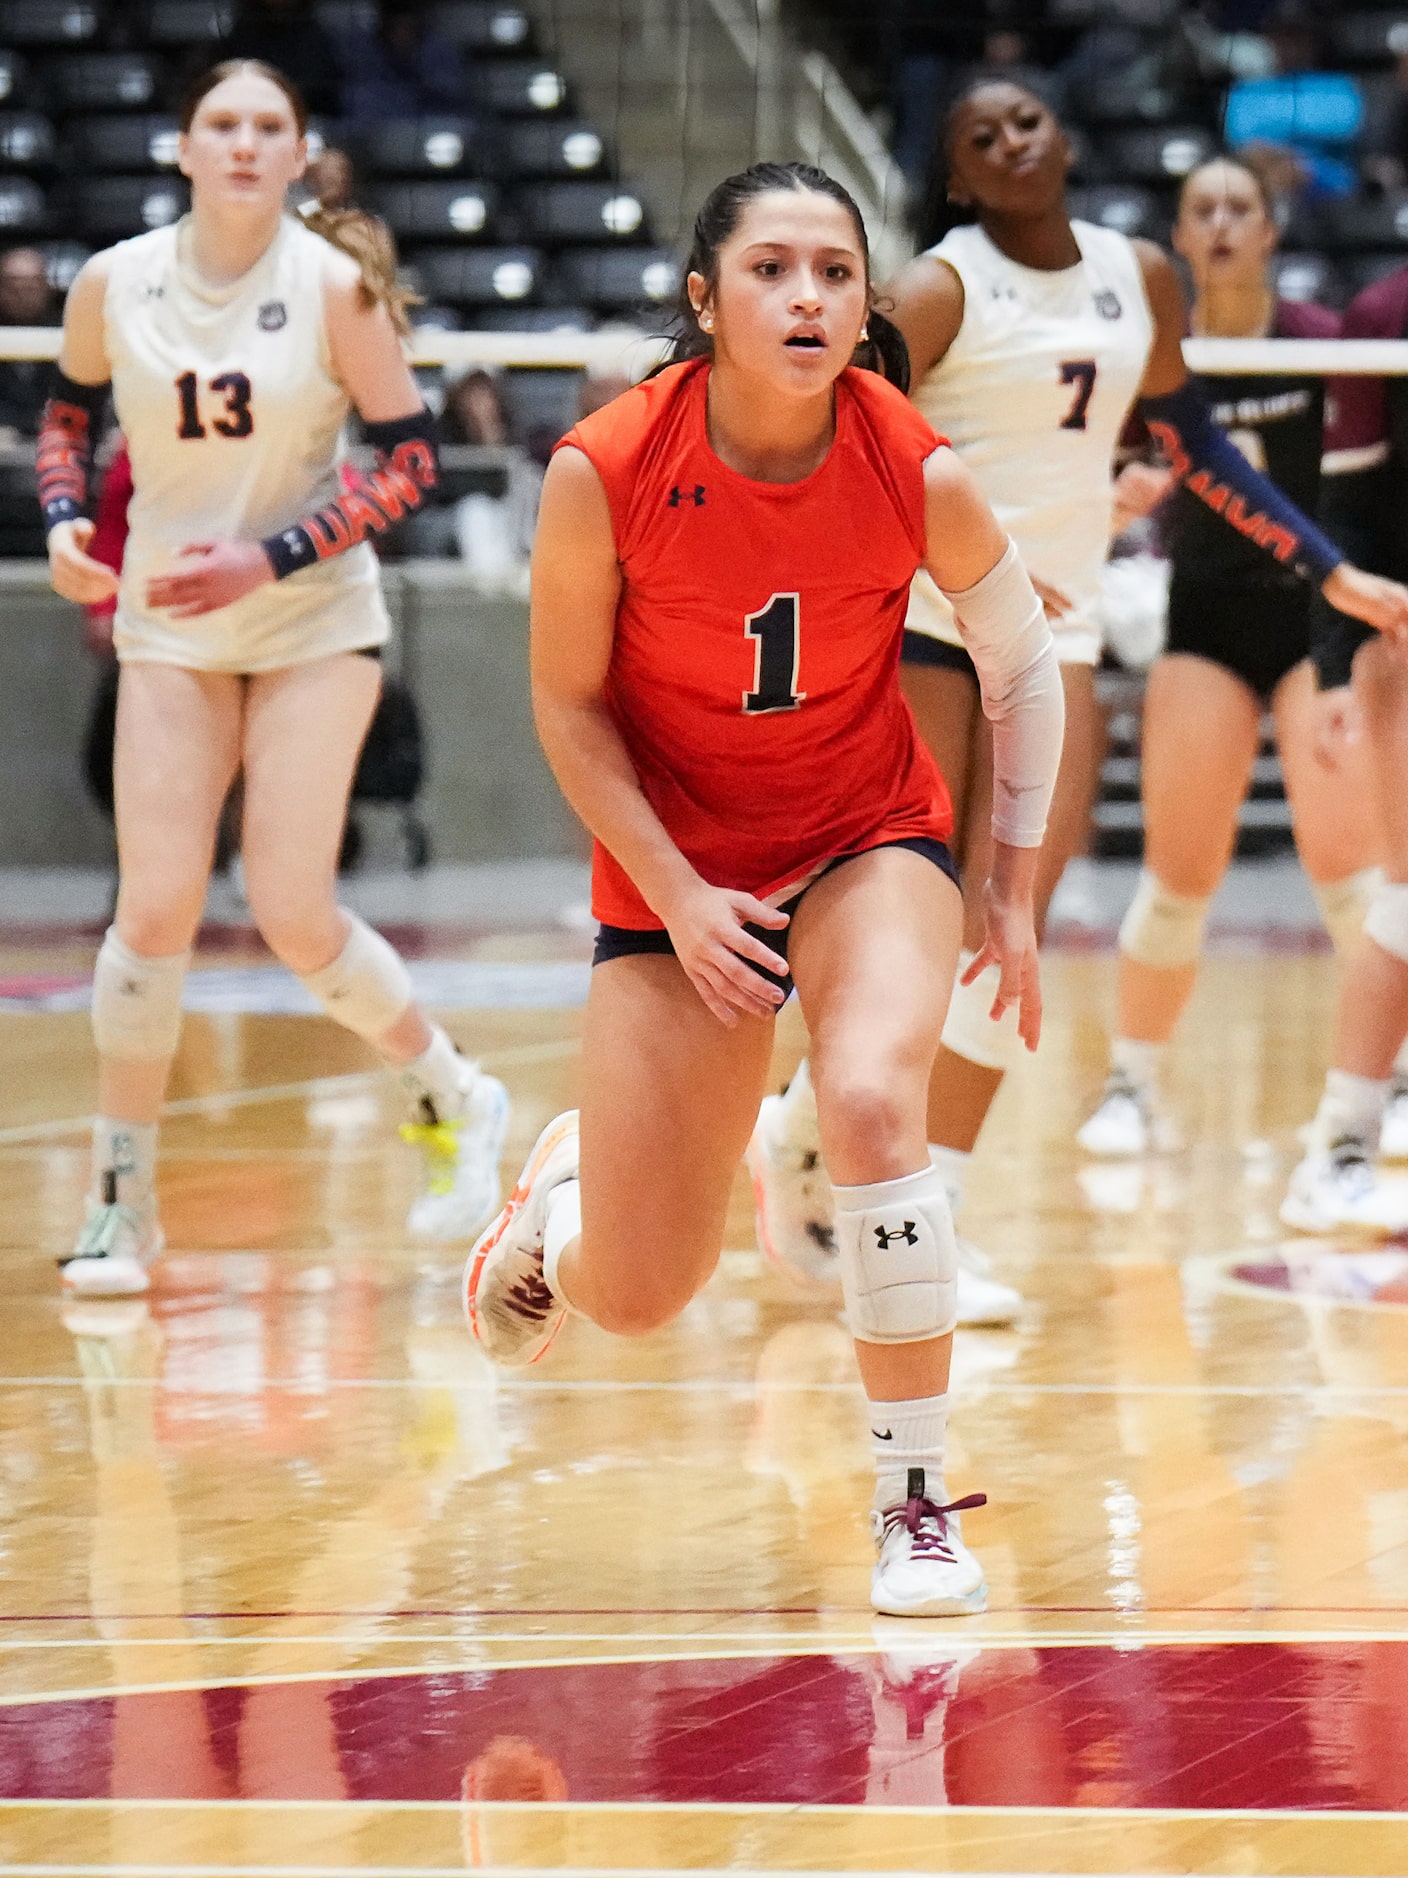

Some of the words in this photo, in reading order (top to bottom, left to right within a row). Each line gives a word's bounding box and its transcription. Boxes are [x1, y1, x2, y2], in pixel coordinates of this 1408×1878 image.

[175, 371, 254, 439] 13
[1059, 359, 1096, 430] 7
[742, 592, 807, 715] 1
